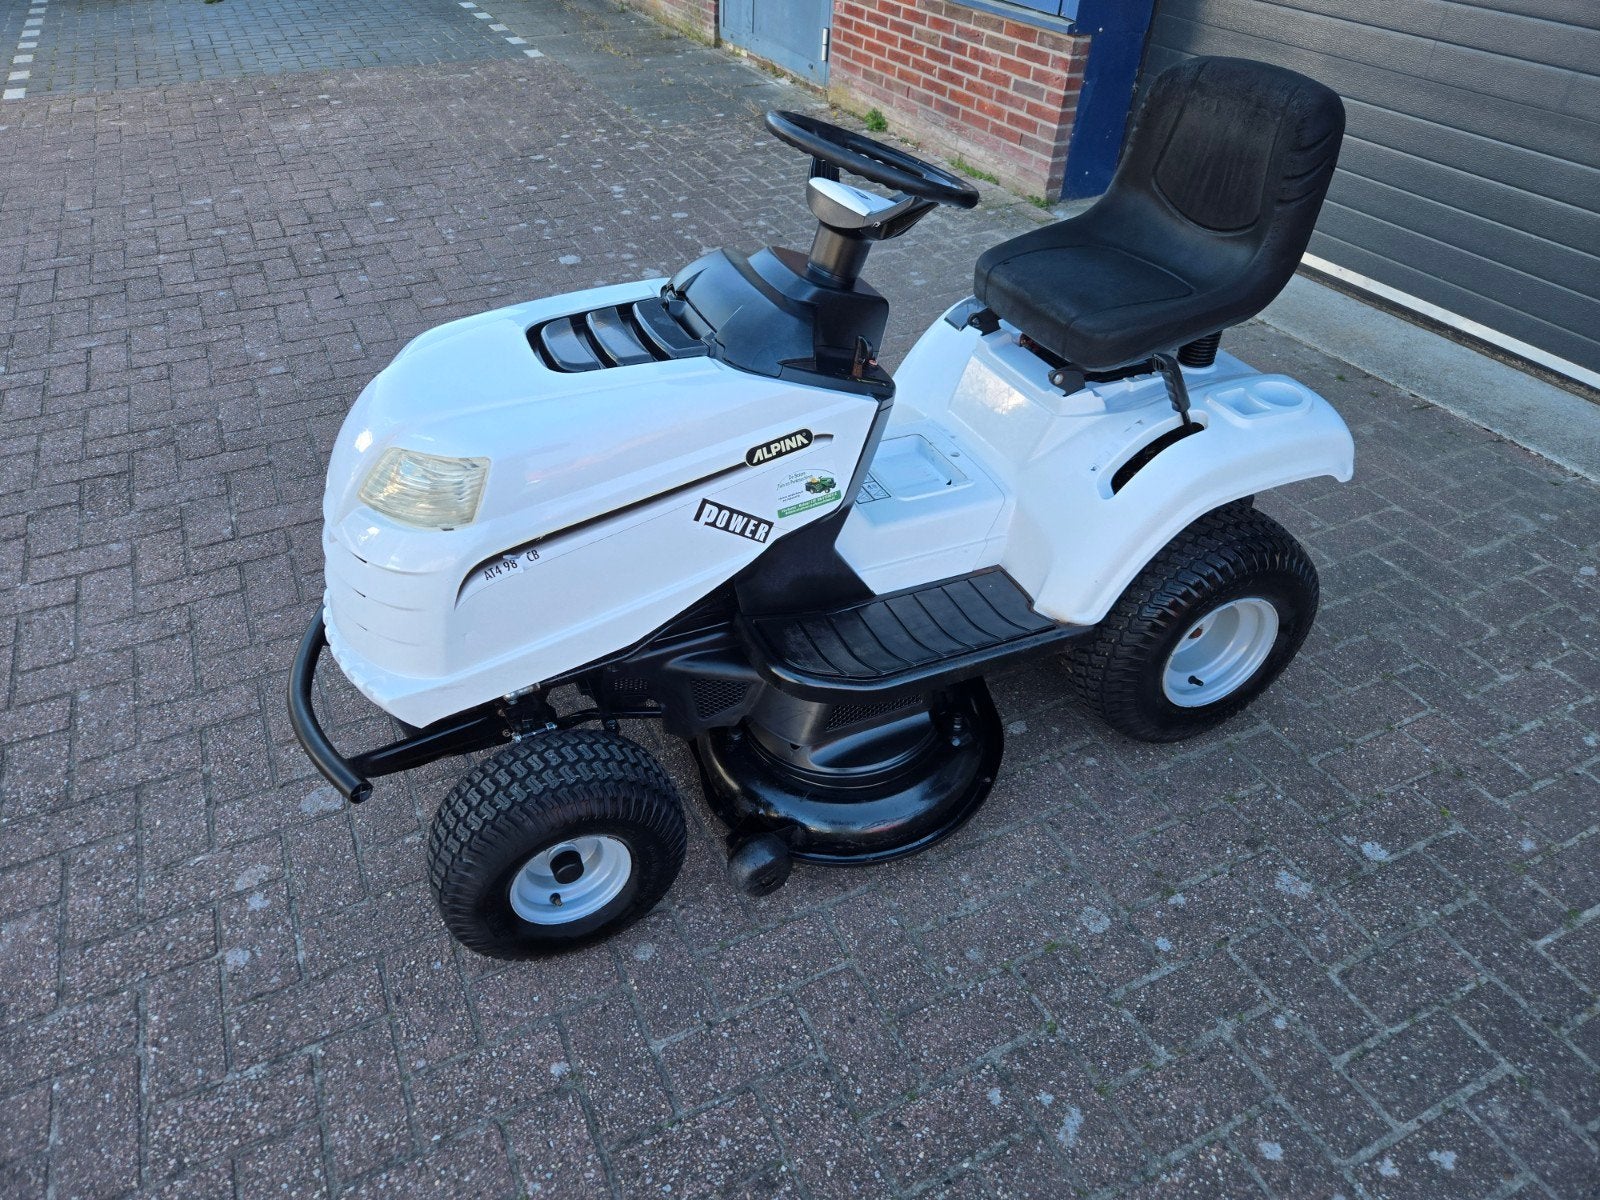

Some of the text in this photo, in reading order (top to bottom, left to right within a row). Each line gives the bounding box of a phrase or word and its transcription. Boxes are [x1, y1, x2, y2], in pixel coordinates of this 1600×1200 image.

[752, 435, 809, 464] ALPINA
[697, 502, 772, 544] POWER
[484, 549, 540, 581] AT4 98 CB
